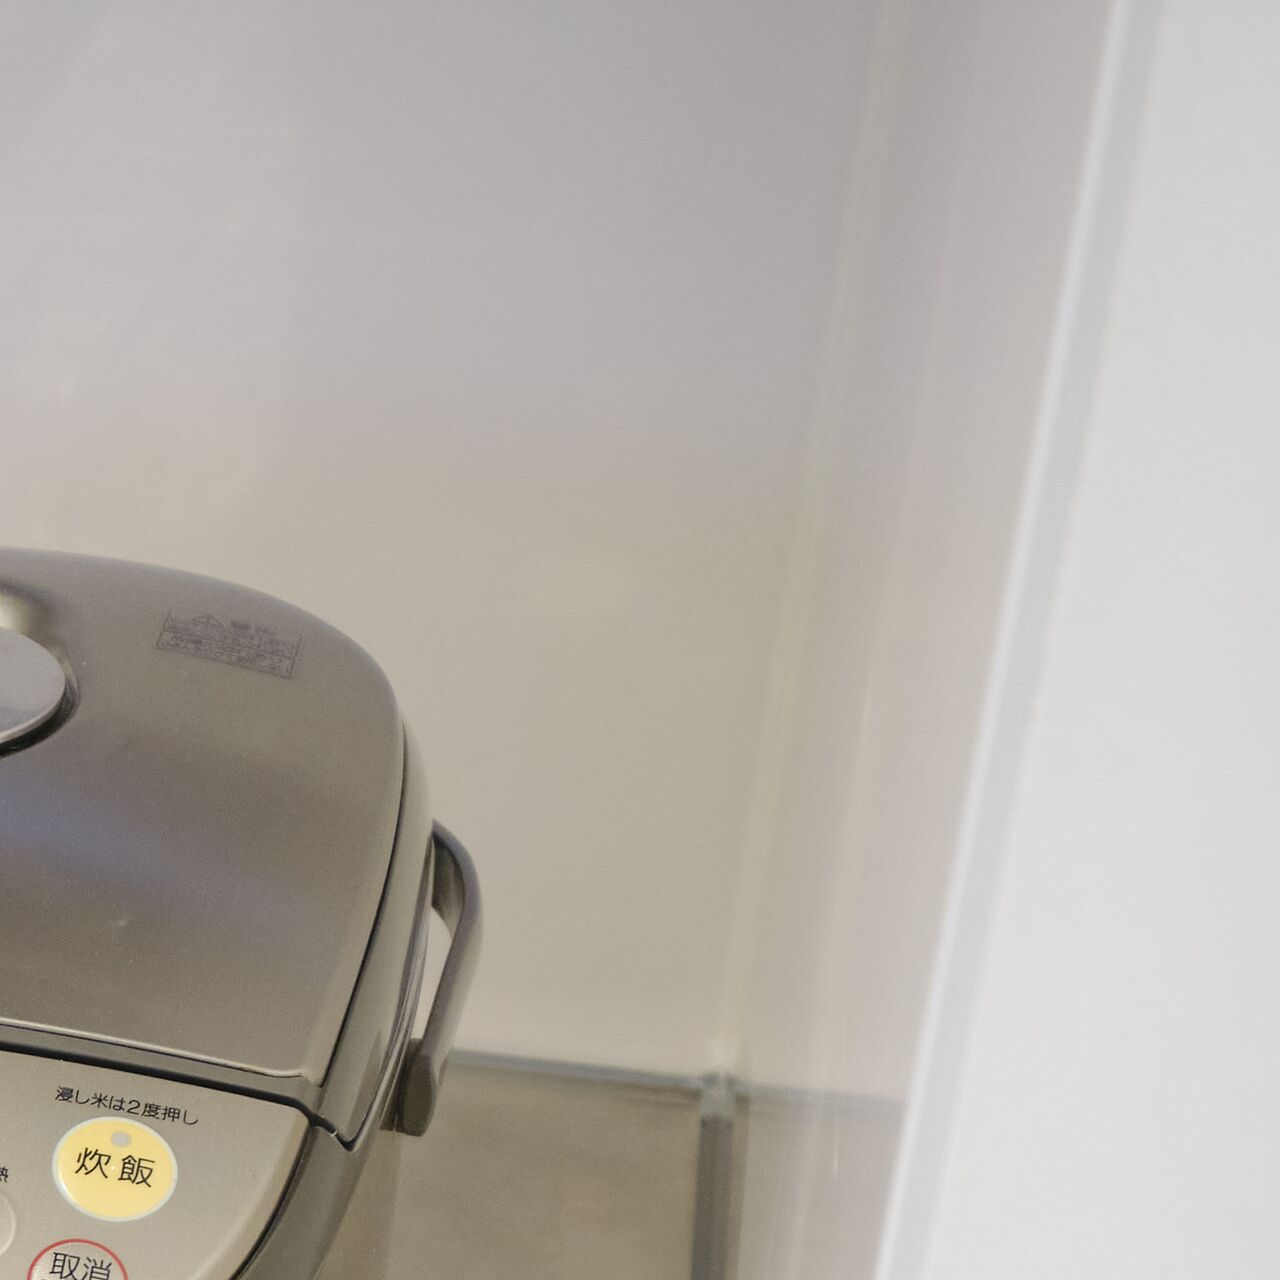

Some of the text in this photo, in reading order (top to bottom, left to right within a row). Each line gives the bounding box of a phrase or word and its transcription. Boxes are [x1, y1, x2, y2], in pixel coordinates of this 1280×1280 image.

[54, 1086, 199, 1126] 浸し米は2度押し
[75, 1147, 156, 1188] 炊飯
